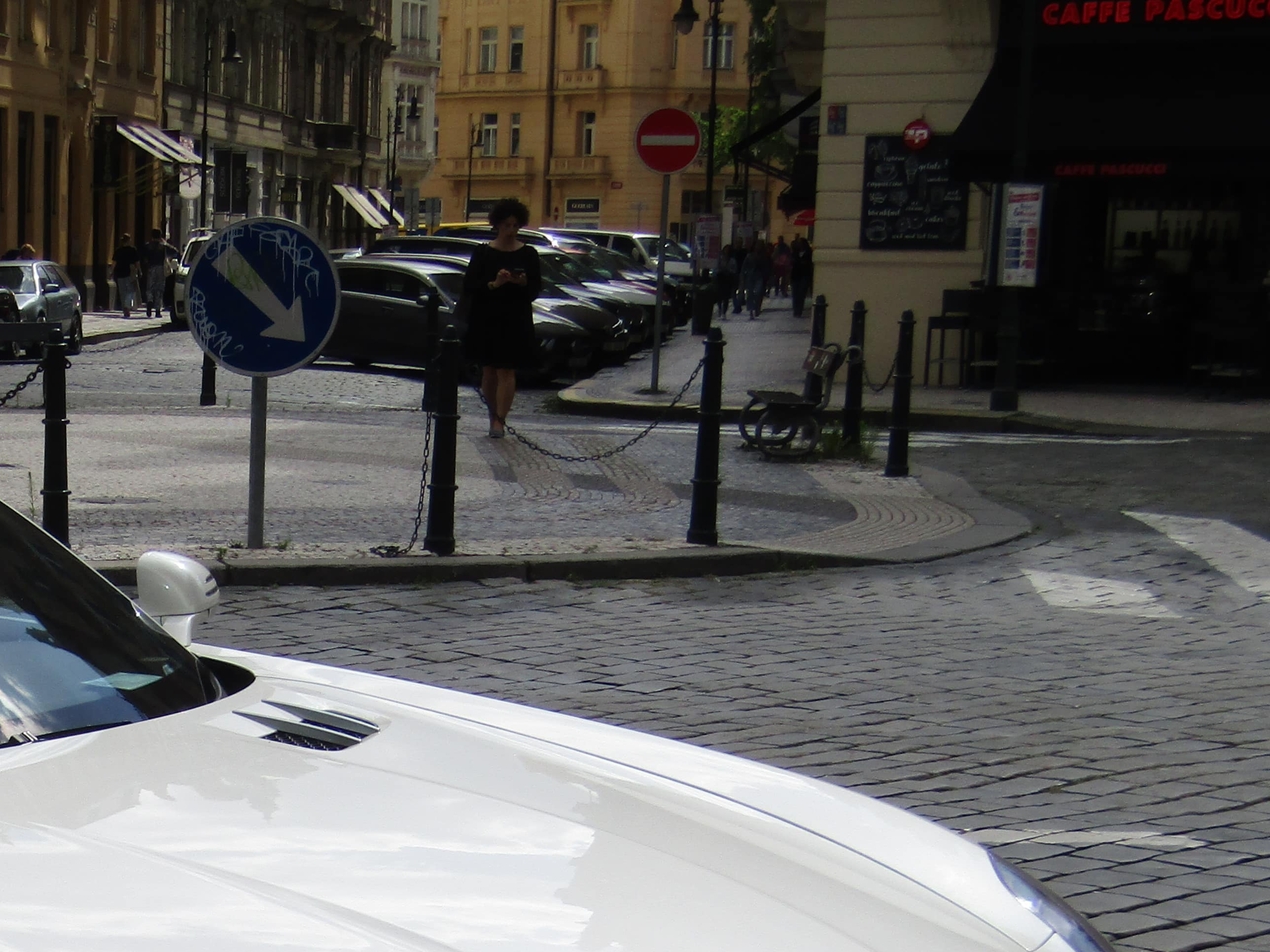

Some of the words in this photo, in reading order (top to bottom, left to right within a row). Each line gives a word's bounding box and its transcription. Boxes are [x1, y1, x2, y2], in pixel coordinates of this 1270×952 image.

[1042, 1, 1132, 26] CAFFE
[1145, 0, 1270, 22] PASCUC
[1054, 163, 1096, 177] CAFFE
[1100, 162, 1169, 175] PASCUCCI
